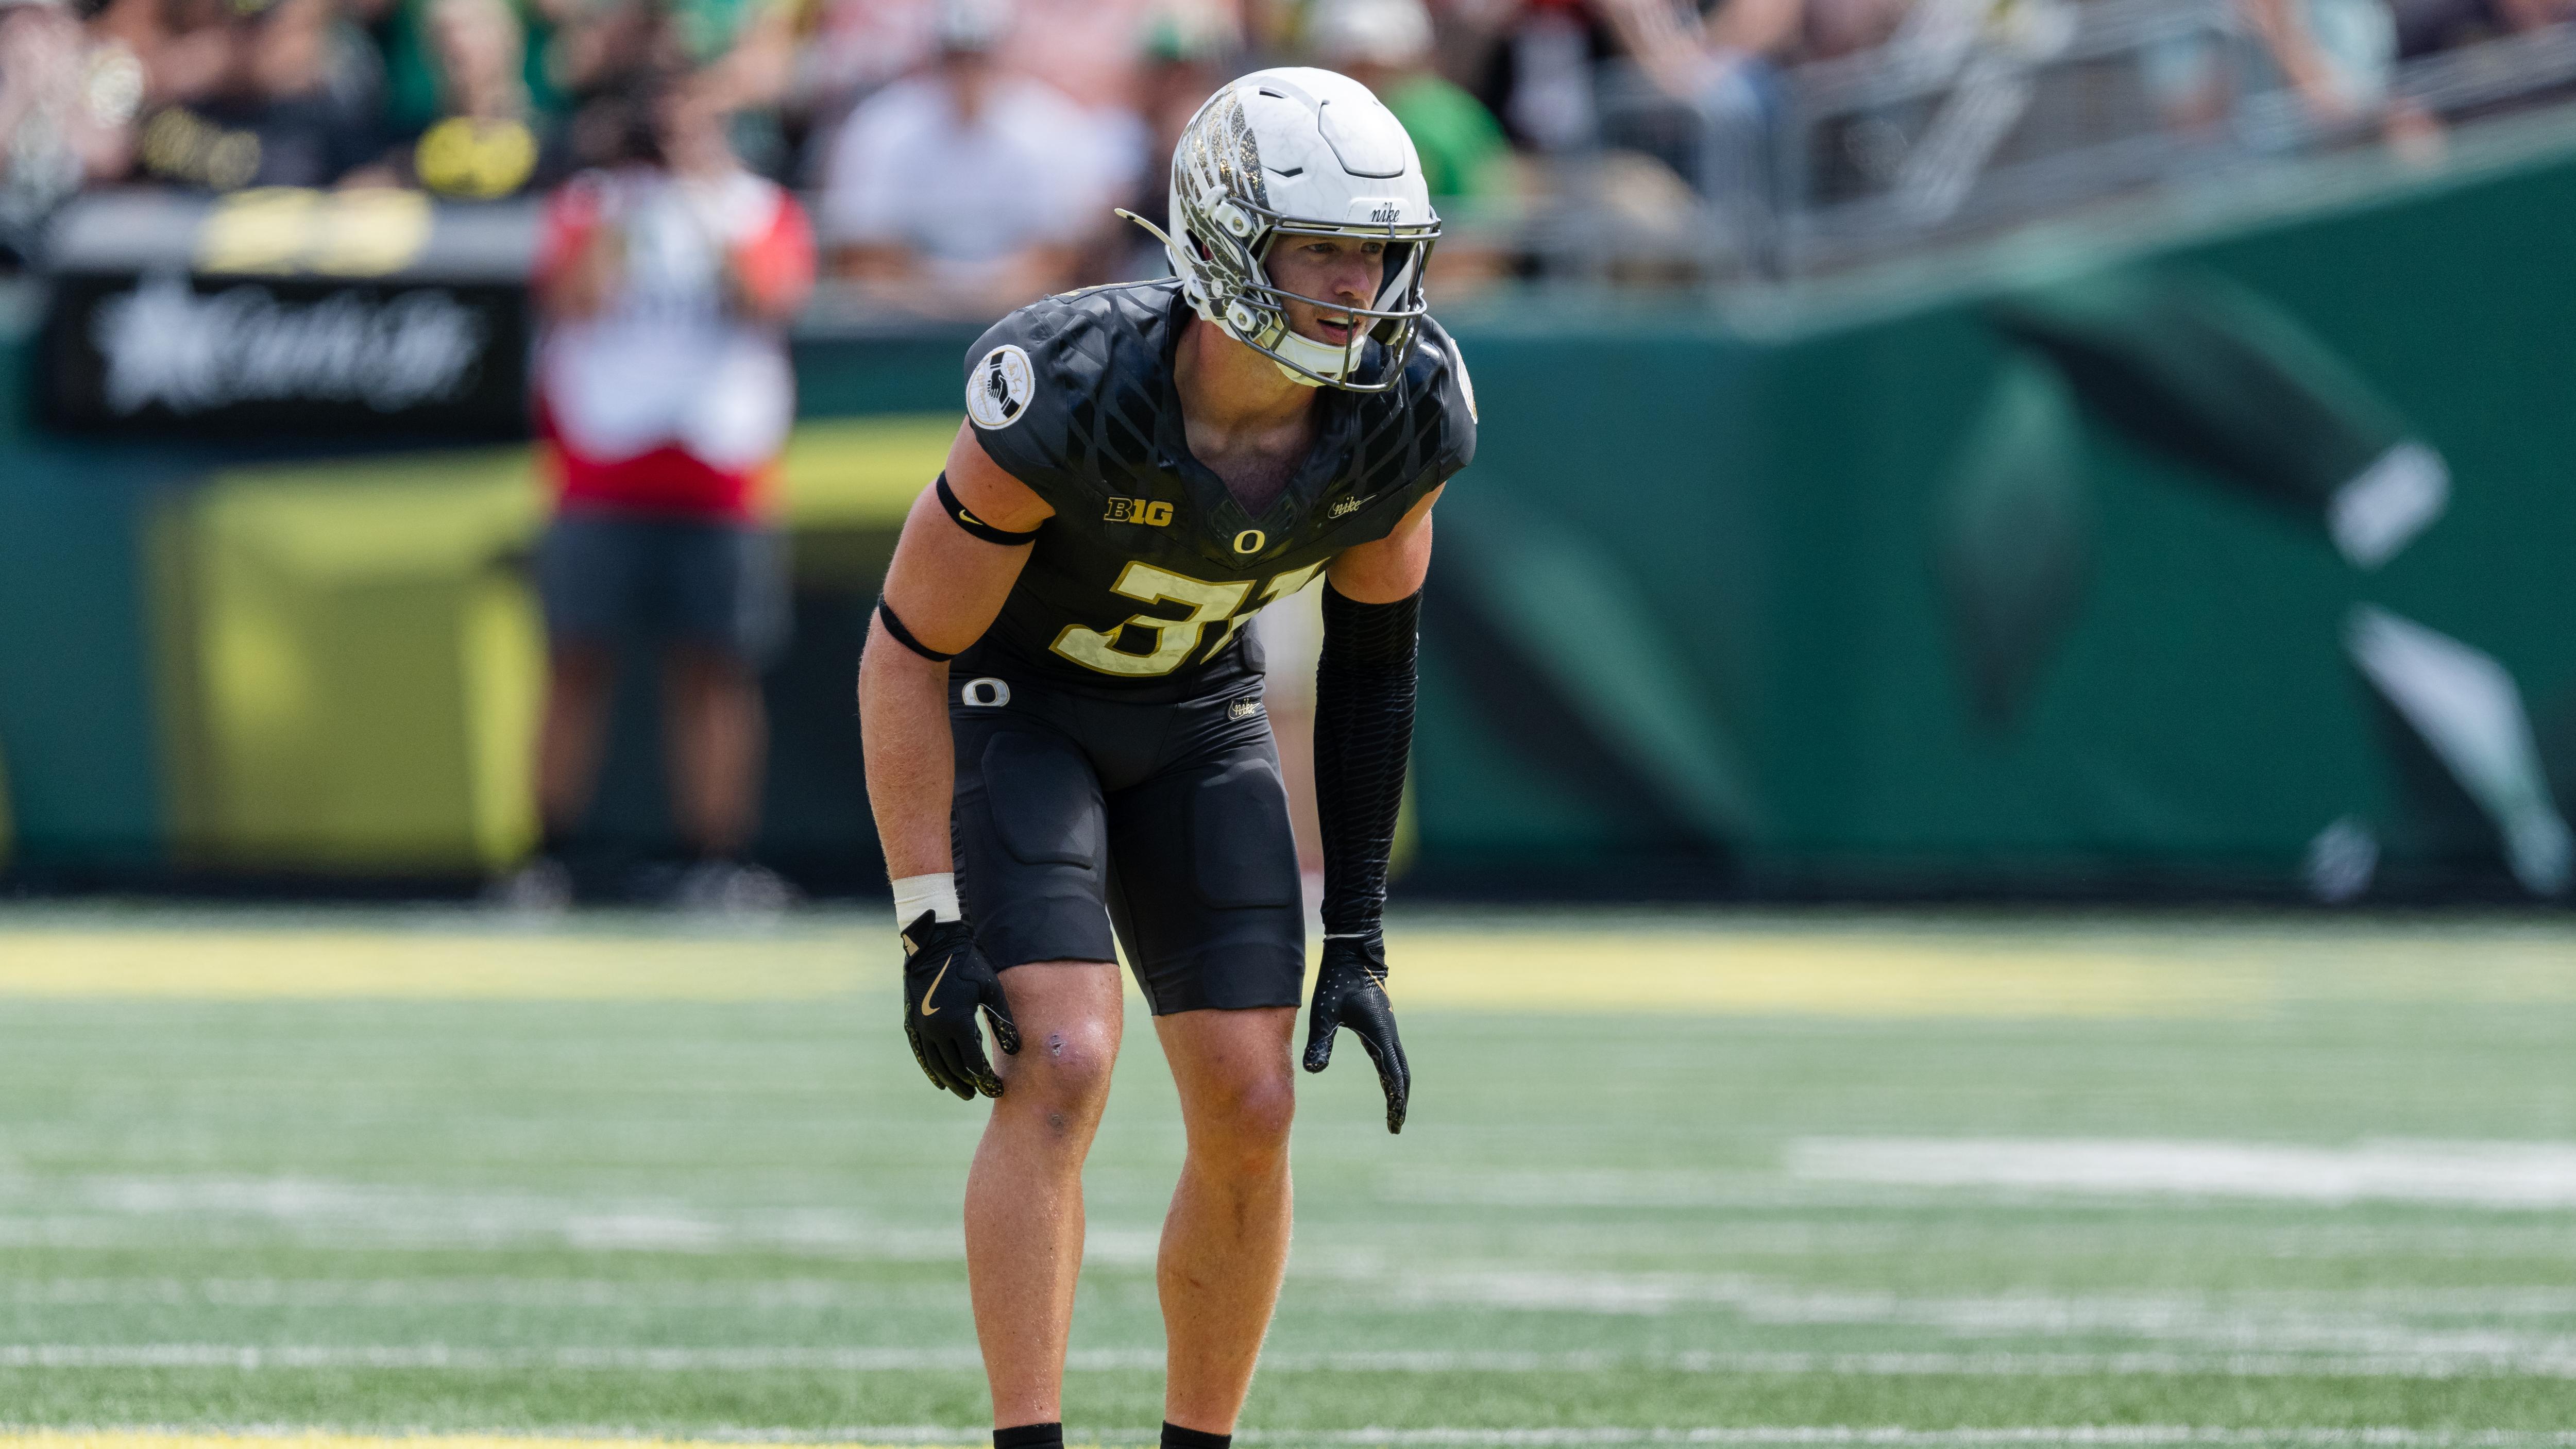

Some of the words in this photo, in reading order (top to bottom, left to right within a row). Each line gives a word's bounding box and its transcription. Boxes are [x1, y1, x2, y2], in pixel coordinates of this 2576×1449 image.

[1371, 199, 1400, 222] nike
[1334, 496, 1360, 515] nike
[1233, 530, 1265, 553] O
[962, 678, 1010, 706] O
